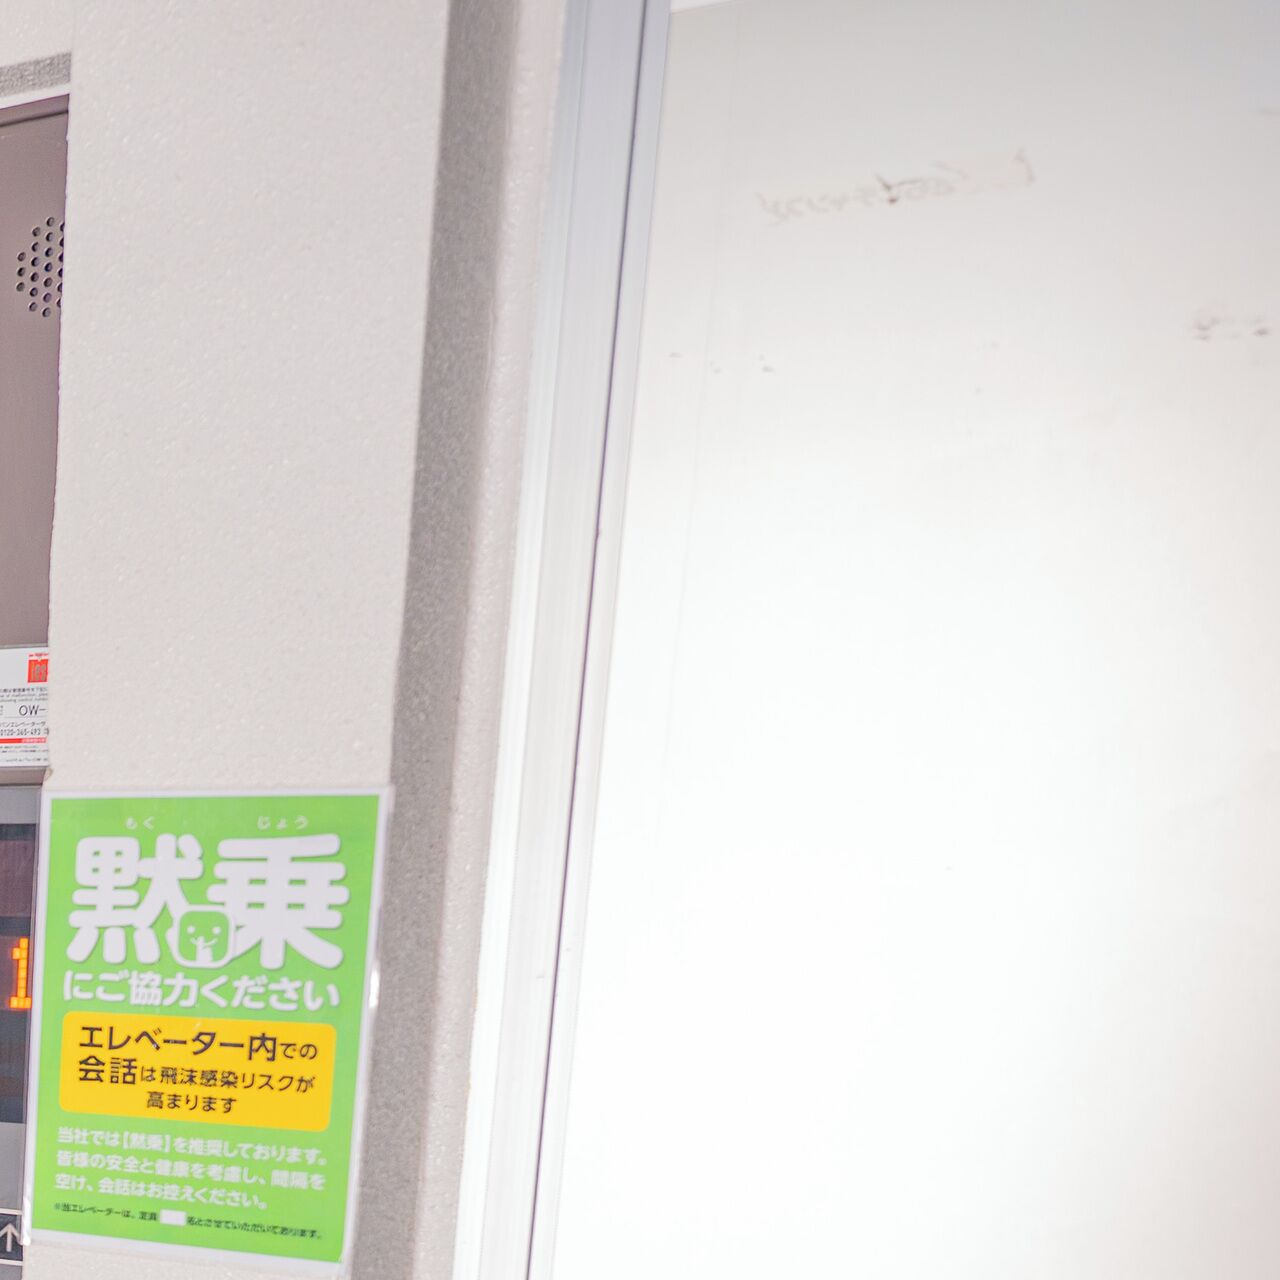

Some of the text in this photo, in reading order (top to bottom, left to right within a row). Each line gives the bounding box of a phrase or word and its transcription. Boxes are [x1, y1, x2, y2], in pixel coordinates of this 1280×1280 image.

[125, 815, 308, 830] もく じょう
[66, 833, 350, 970] 黙乗
[10, 937, 32, 1009] 1
[63, 969, 340, 1011] にご協力ください
[79, 1026, 319, 1062] エレベーター内での
[78, 1055, 316, 1093] 会話は飛沫感染リスクが
[146, 1091, 237, 1114] 高まります
